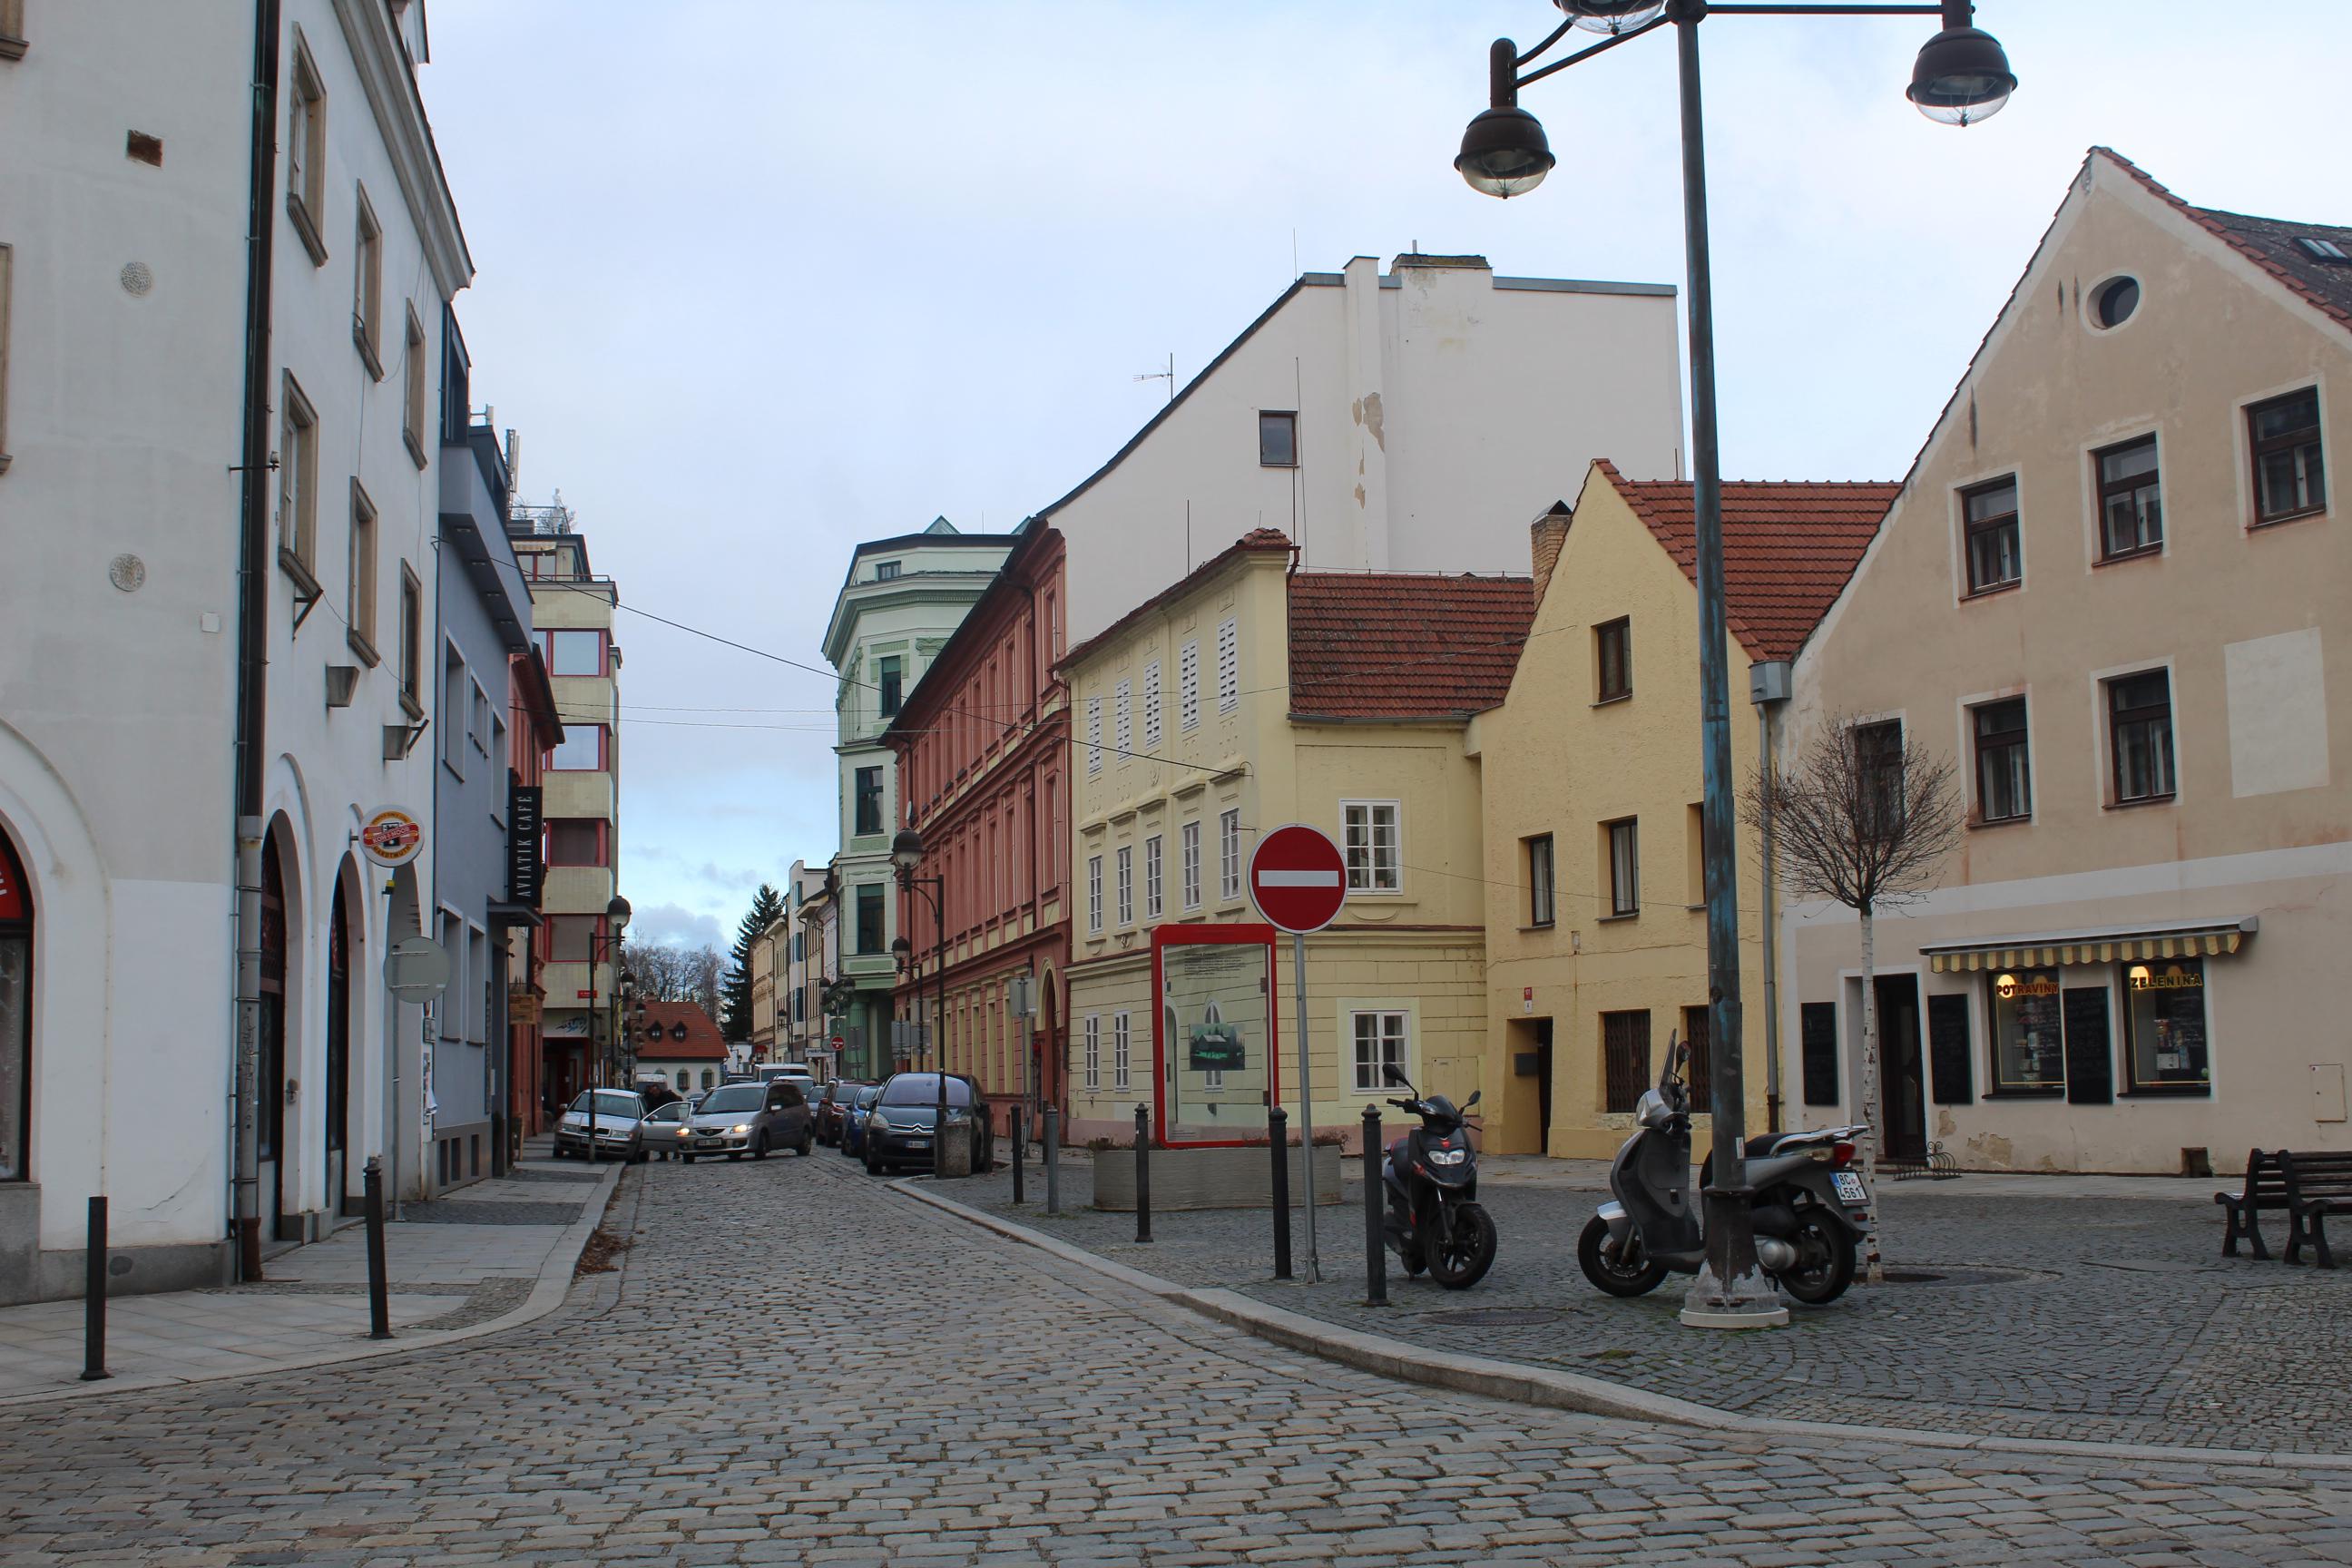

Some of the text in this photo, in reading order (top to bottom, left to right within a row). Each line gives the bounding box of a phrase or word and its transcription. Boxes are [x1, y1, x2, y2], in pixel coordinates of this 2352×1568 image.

[517, 796, 532, 897] AVIATIK CAFE
[2131, 974, 2203, 989] ZELENINA
[1996, 983, 2059, 995] POTRAVINY
[1838, 1174, 1851, 1185] 8C
[1839, 1187, 1863, 1199] 4561
